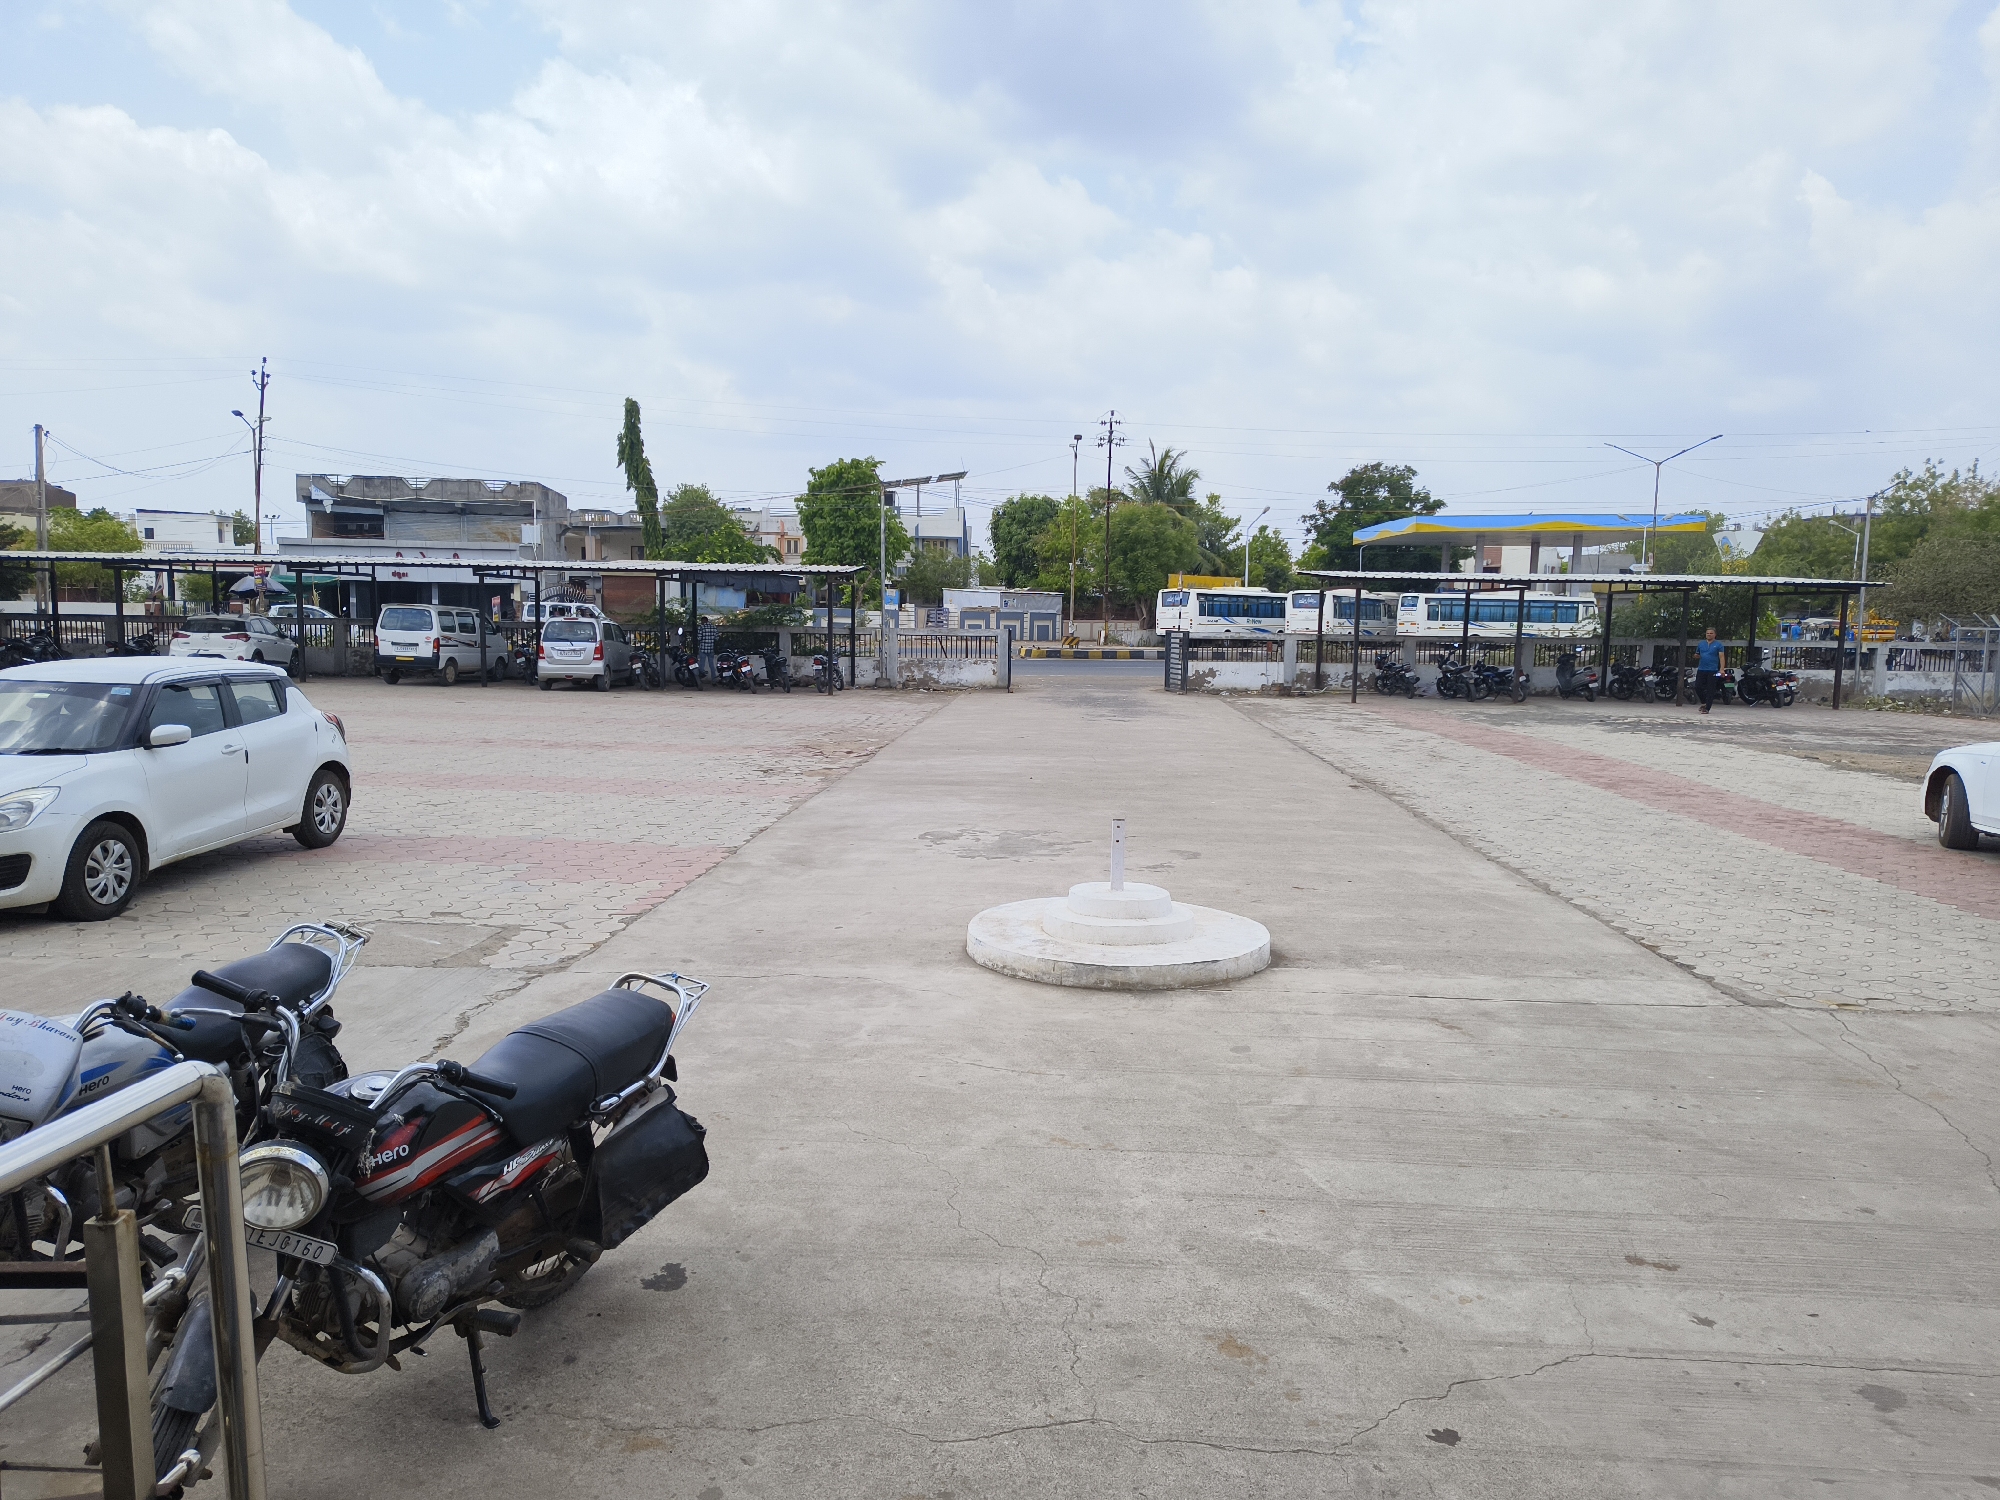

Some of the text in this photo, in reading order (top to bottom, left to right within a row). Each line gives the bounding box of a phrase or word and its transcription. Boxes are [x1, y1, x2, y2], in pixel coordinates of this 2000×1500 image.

[12, 1085, 32, 1095] Hero
[79, 1075, 109, 1096] Hero
[370, 1144, 409, 1167] Hero
[248, 1229, 324, 1261] 1EJ0160
